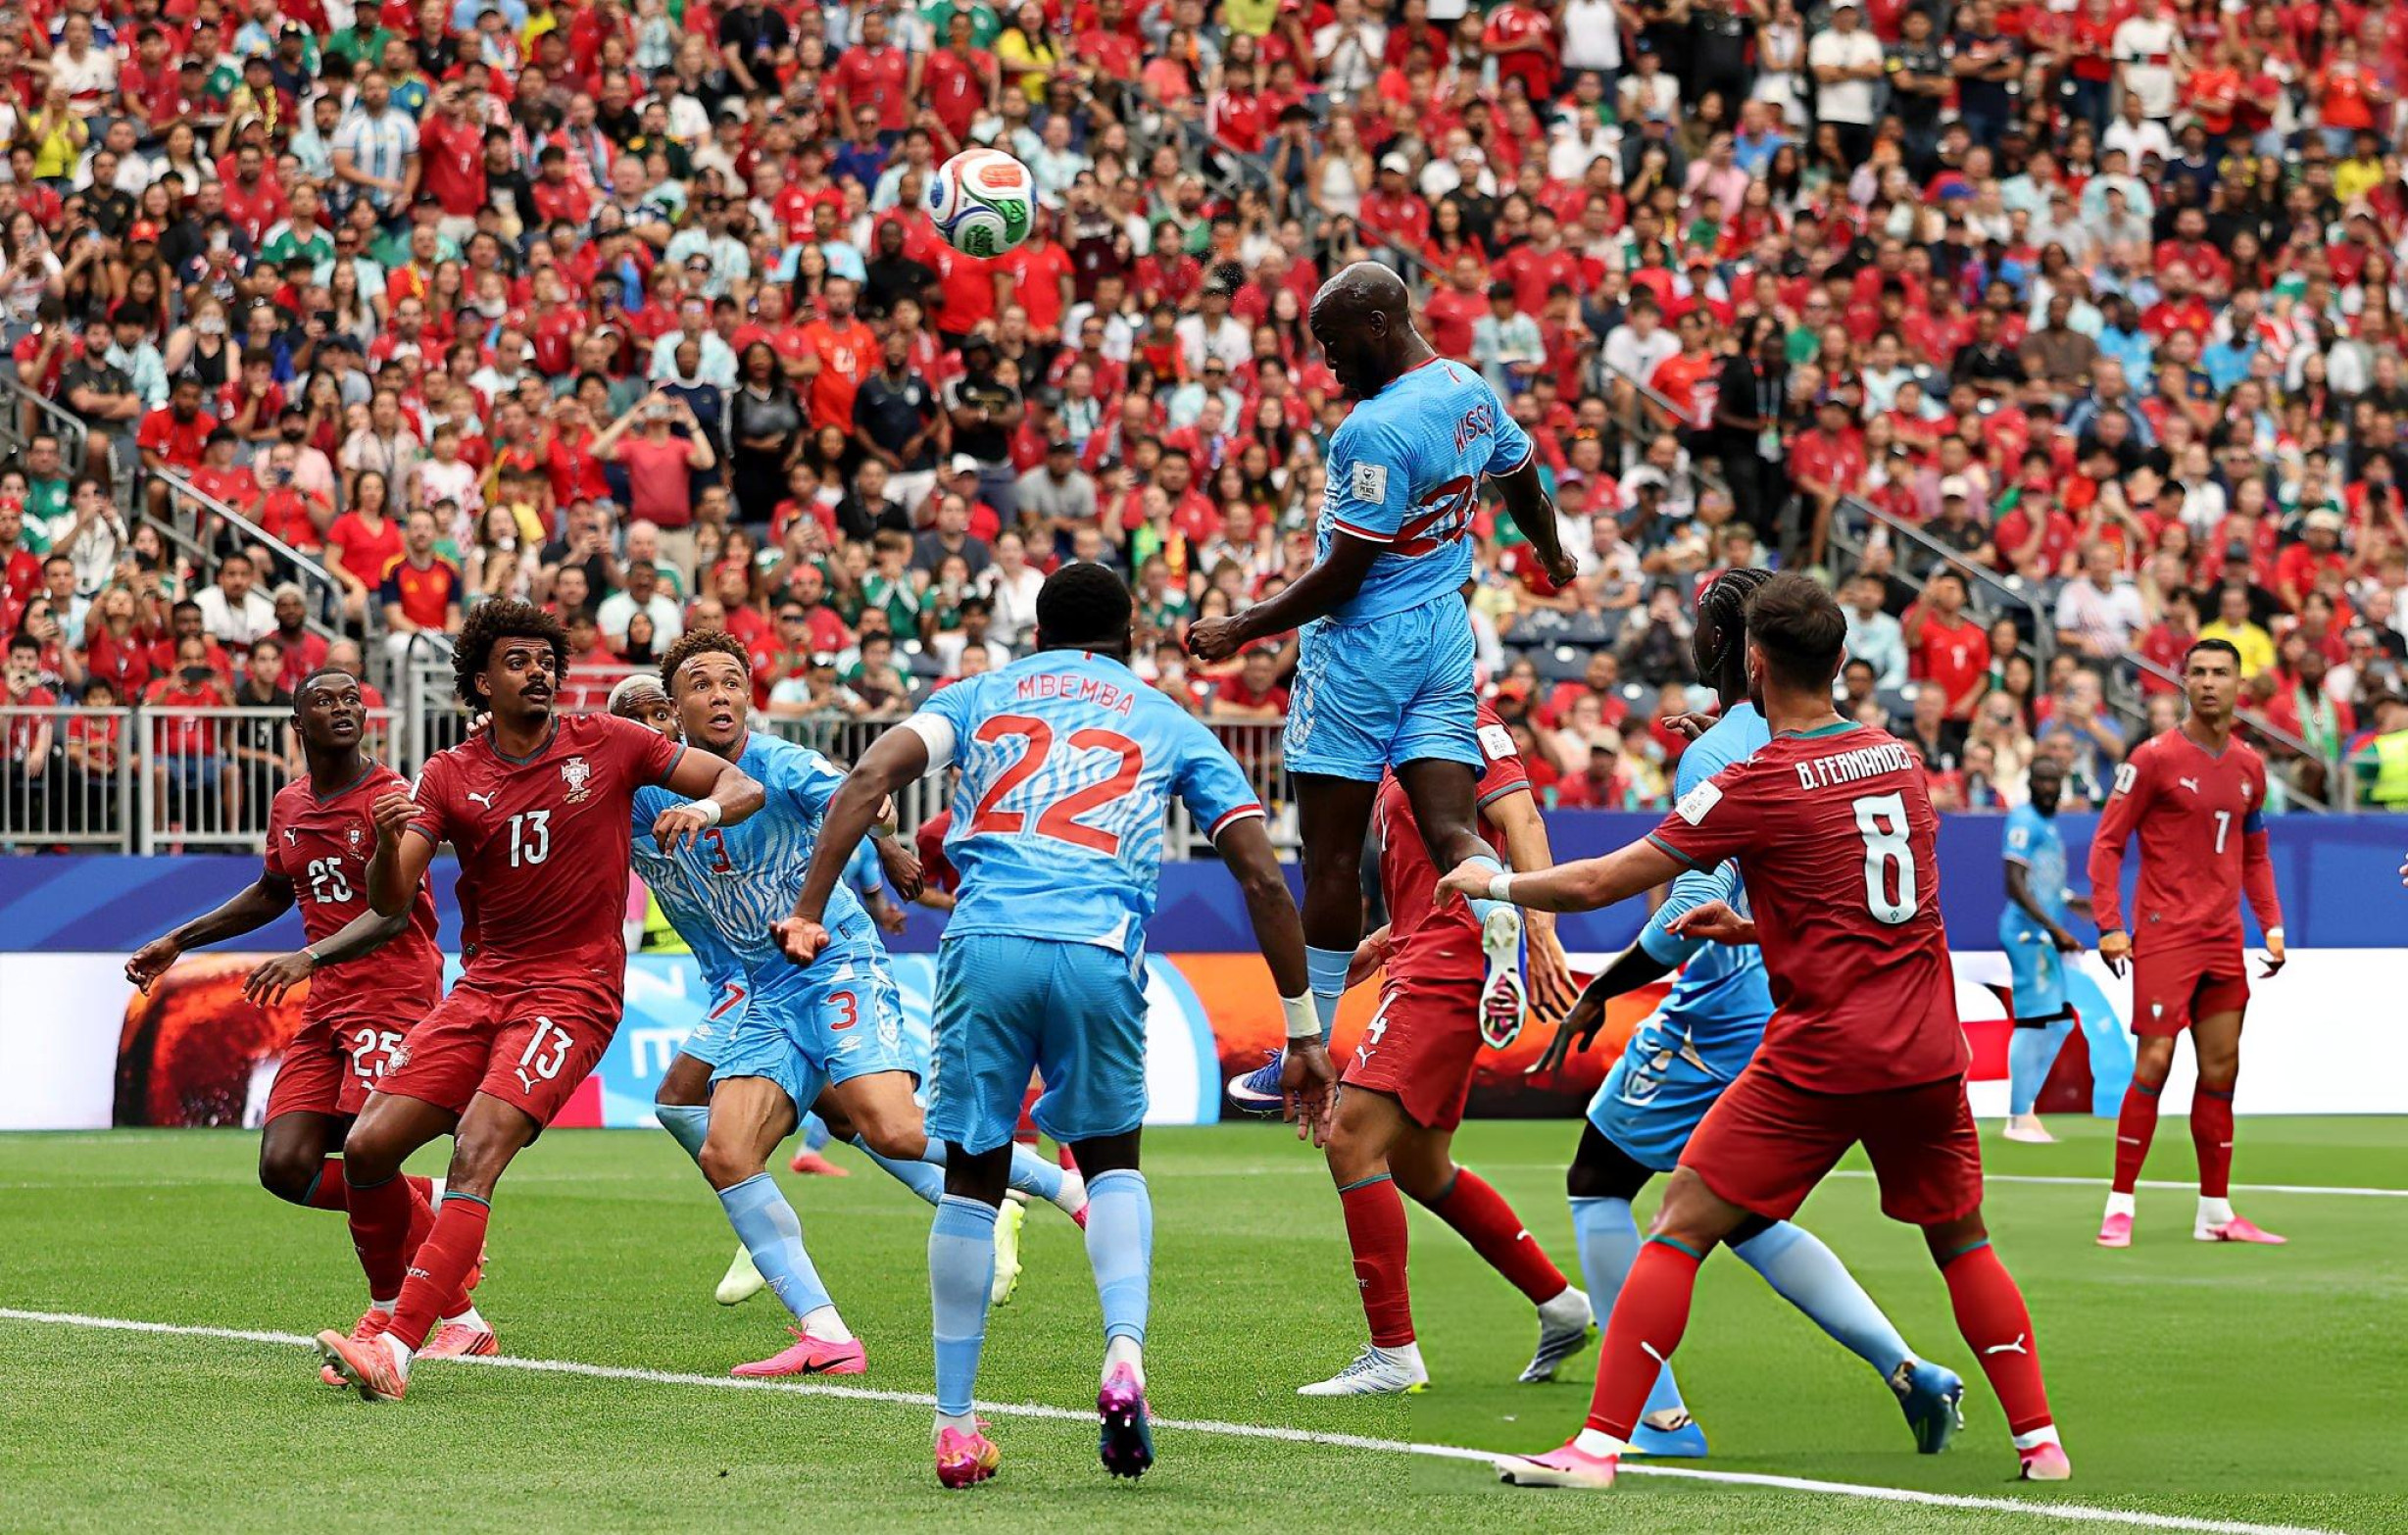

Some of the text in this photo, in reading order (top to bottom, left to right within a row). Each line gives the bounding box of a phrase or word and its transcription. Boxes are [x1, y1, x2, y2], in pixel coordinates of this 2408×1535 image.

[1016, 673, 1137, 717] MBEMBA
[969, 714, 1145, 858] 22
[508, 809, 551, 868] 13
[704, 828, 732, 874] 3
[2214, 810, 2231, 855] 7
[308, 857, 353, 903] 25
[1851, 790, 1919, 924] 8
[710, 982, 746, 1020] 7
[827, 989, 859, 1031] 3
[1366, 991, 1398, 1046] 4
[353, 1028, 403, 1078] 25
[519, 1015, 574, 1080] 13
